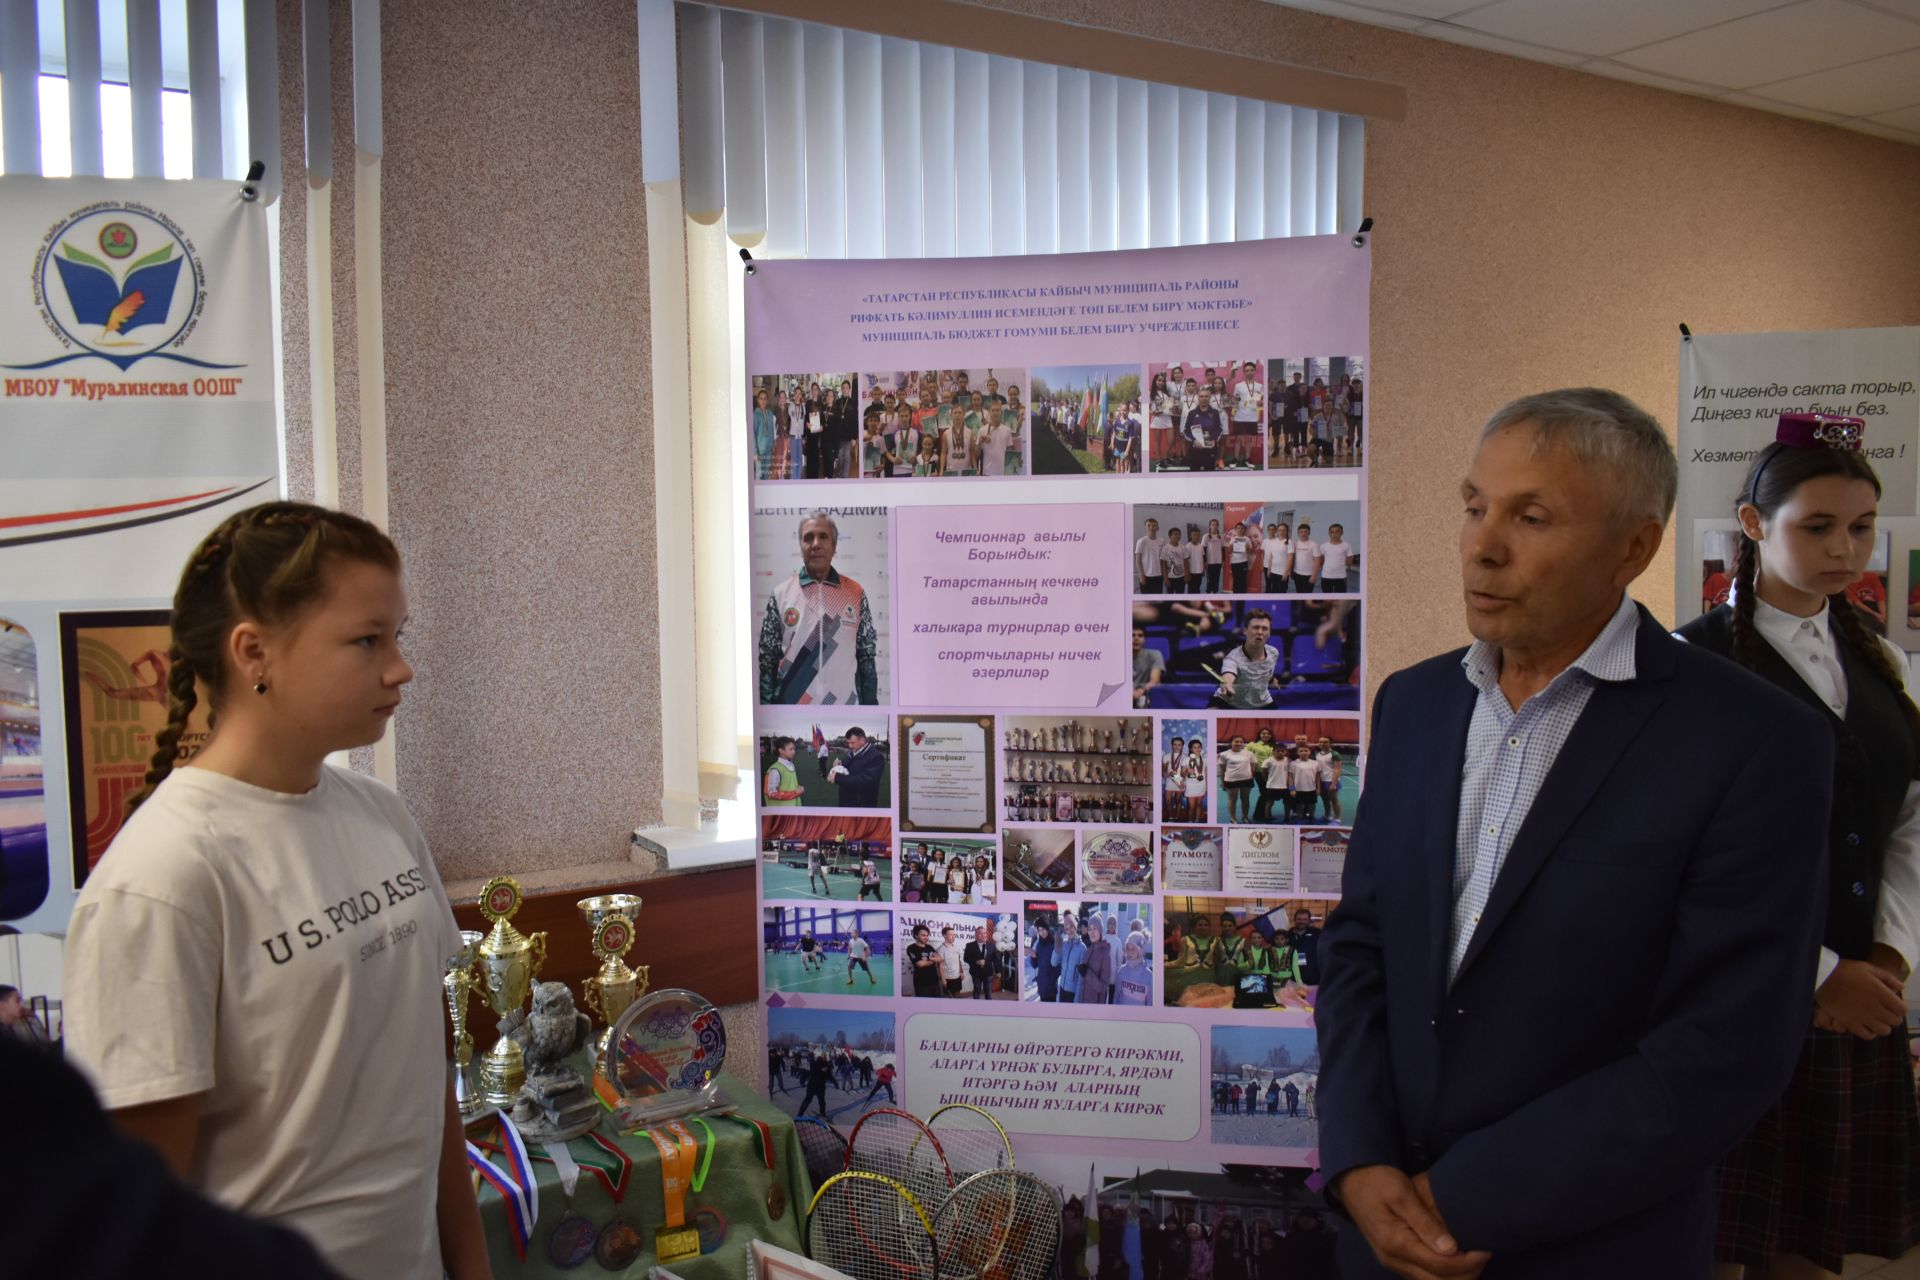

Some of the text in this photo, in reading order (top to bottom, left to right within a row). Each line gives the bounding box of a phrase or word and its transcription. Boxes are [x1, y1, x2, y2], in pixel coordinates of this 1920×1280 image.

[939, 287, 1036, 301] РЕСПУБЛИКАСЫ
[1039, 284, 1091, 297] КАЙБЫЧ
[1094, 281, 1182, 297] МУНИЦИПАЛЬ
[1185, 278, 1239, 291] РАЙОНЫ
[850, 312, 905, 324] РИФКАТЬ
[908, 310, 992, 322] КӘЛИМУЛЛИН
[995, 305, 1076, 320] ИСЕМЕНДӘГЕ
[1079, 304, 1104, 316] ТӨП
[1107, 303, 1149, 314] БЕЛЕМ
[862, 330, 946, 344] МУНИЦИПАЛЬ
[949, 328, 1001, 341] БЮДЖЕТ
[1004, 326, 1058, 338] ГОМУМИ
[1061, 324, 1102, 336] БЕЛЕМ
[1140, 319, 1240, 333] УЧРЕЖДЕНИЕСЕ
[5, 378, 243, 401] МБОУ "Муралинская ООШ"
[1693, 381, 1915, 400] Ил чигендә сакта торыр,
[1691, 406, 1751, 422] Диңгез
[1856, 401, 1889, 416] без.
[935, 530, 1086, 546] Чемпионнар авылы
[967, 547, 1052, 563] Борындык:
[923, 575, 1099, 591] Татарстанның кечкенә
[971, 592, 1049, 606] авылында
[912, 622, 1110, 636] халыкара турнирлар өчен
[937, 649, 1102, 664] спортчыларны ничек
[971, 667, 1050, 681] әзерлиләр
[922, 753, 966, 763] Сертификат
[1172, 850, 1213, 859] ГРАМОТА
[1241, 851, 1280, 860] ДИПЛОМ
[323, 890, 381, 933] POLO
[381, 867, 430, 906] ASS
[388, 919, 418, 945] 1890
[919, 1039, 1184, 1064] БАЛАЛАРНЫ ӨЙРӘТЕРГӘ КИРӘКМИ,
[929, 1058, 1174, 1080] АЛАРГА ҮРНӘК БУЛЫРГА, ЯРДӘМ
[962, 1076, 1141, 1097] ИТӘРГӘ ҺӘМ АЛАРНЫҢ
[1042, 1097, 1110, 1113] ЯУЛАРГА
[1113, 1102, 1166, 1116] КИРӘК
